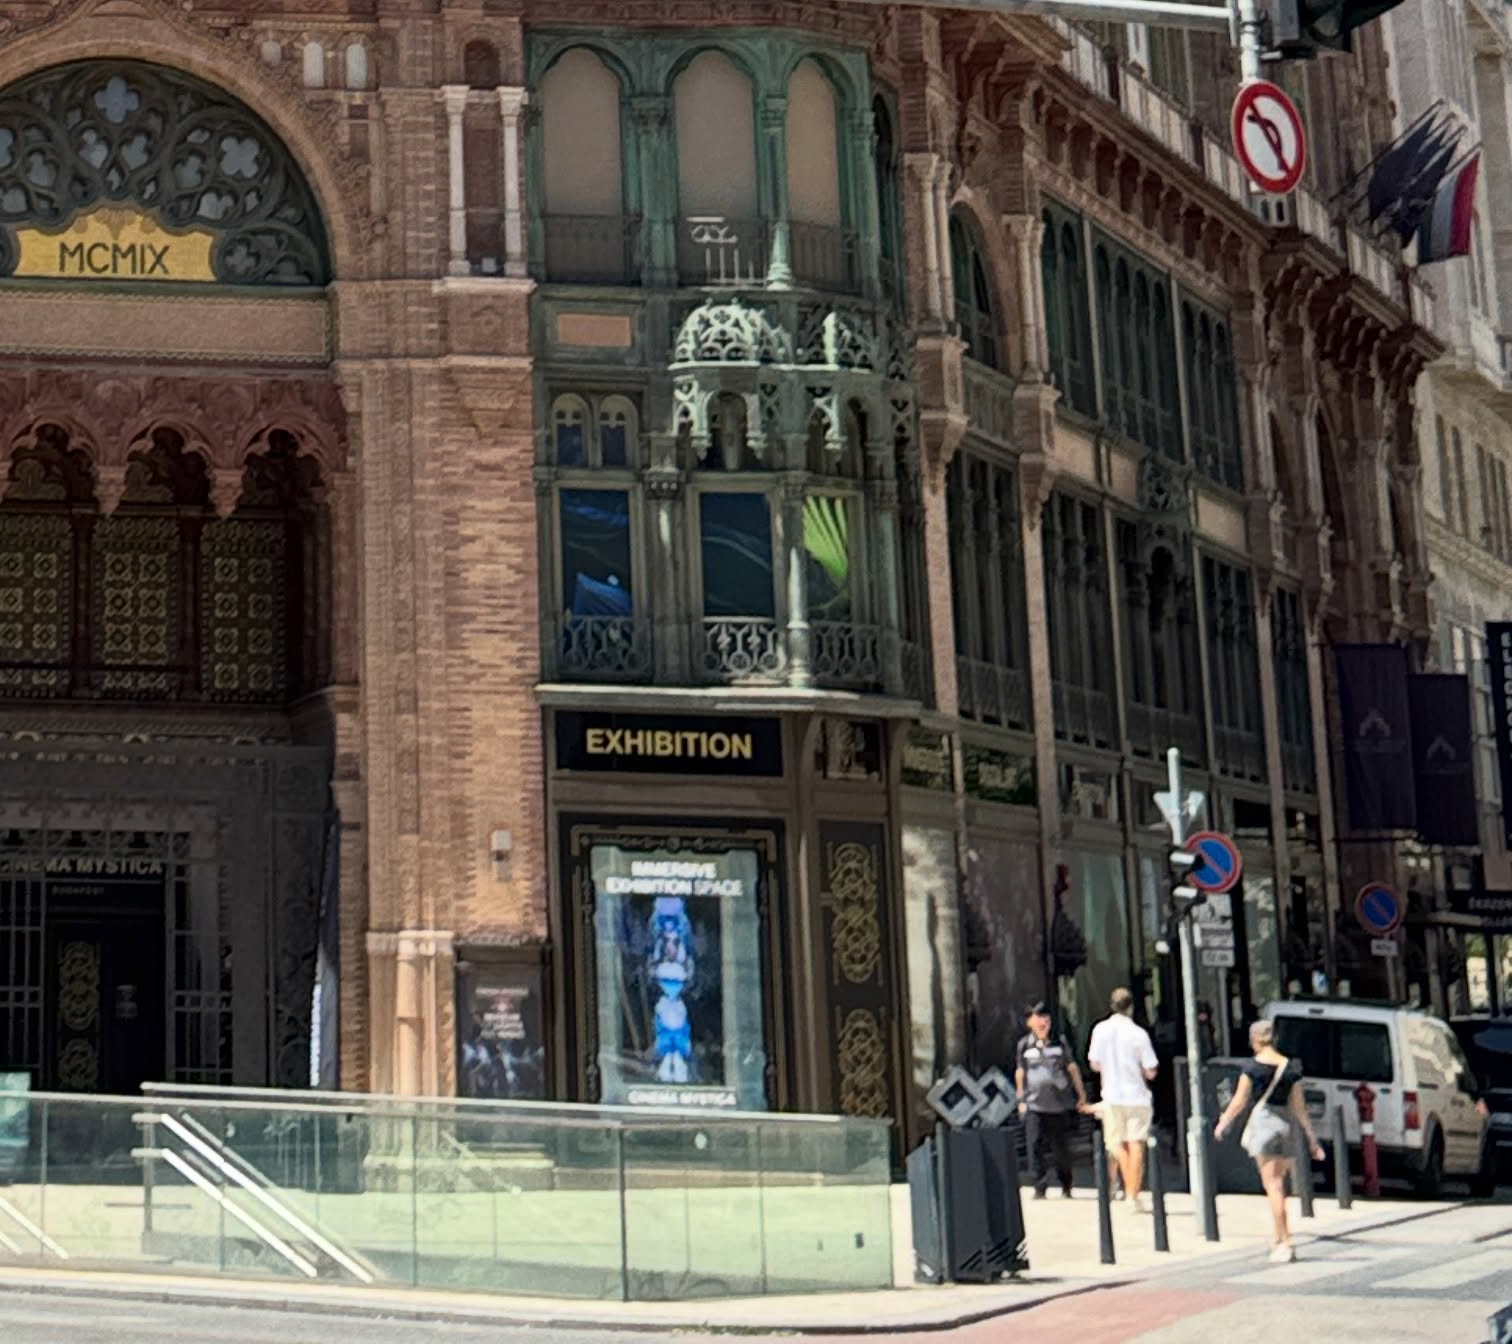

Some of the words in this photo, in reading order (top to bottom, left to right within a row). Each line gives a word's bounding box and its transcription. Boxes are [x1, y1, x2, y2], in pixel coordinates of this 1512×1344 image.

[59, 241, 170, 275] MCMIX
[586, 729, 752, 759] EXHIBITION
[76, 857, 163, 875] MYSTICA
[606, 877, 692, 895] EXHIBITION
[693, 879, 743, 897] SPACE
